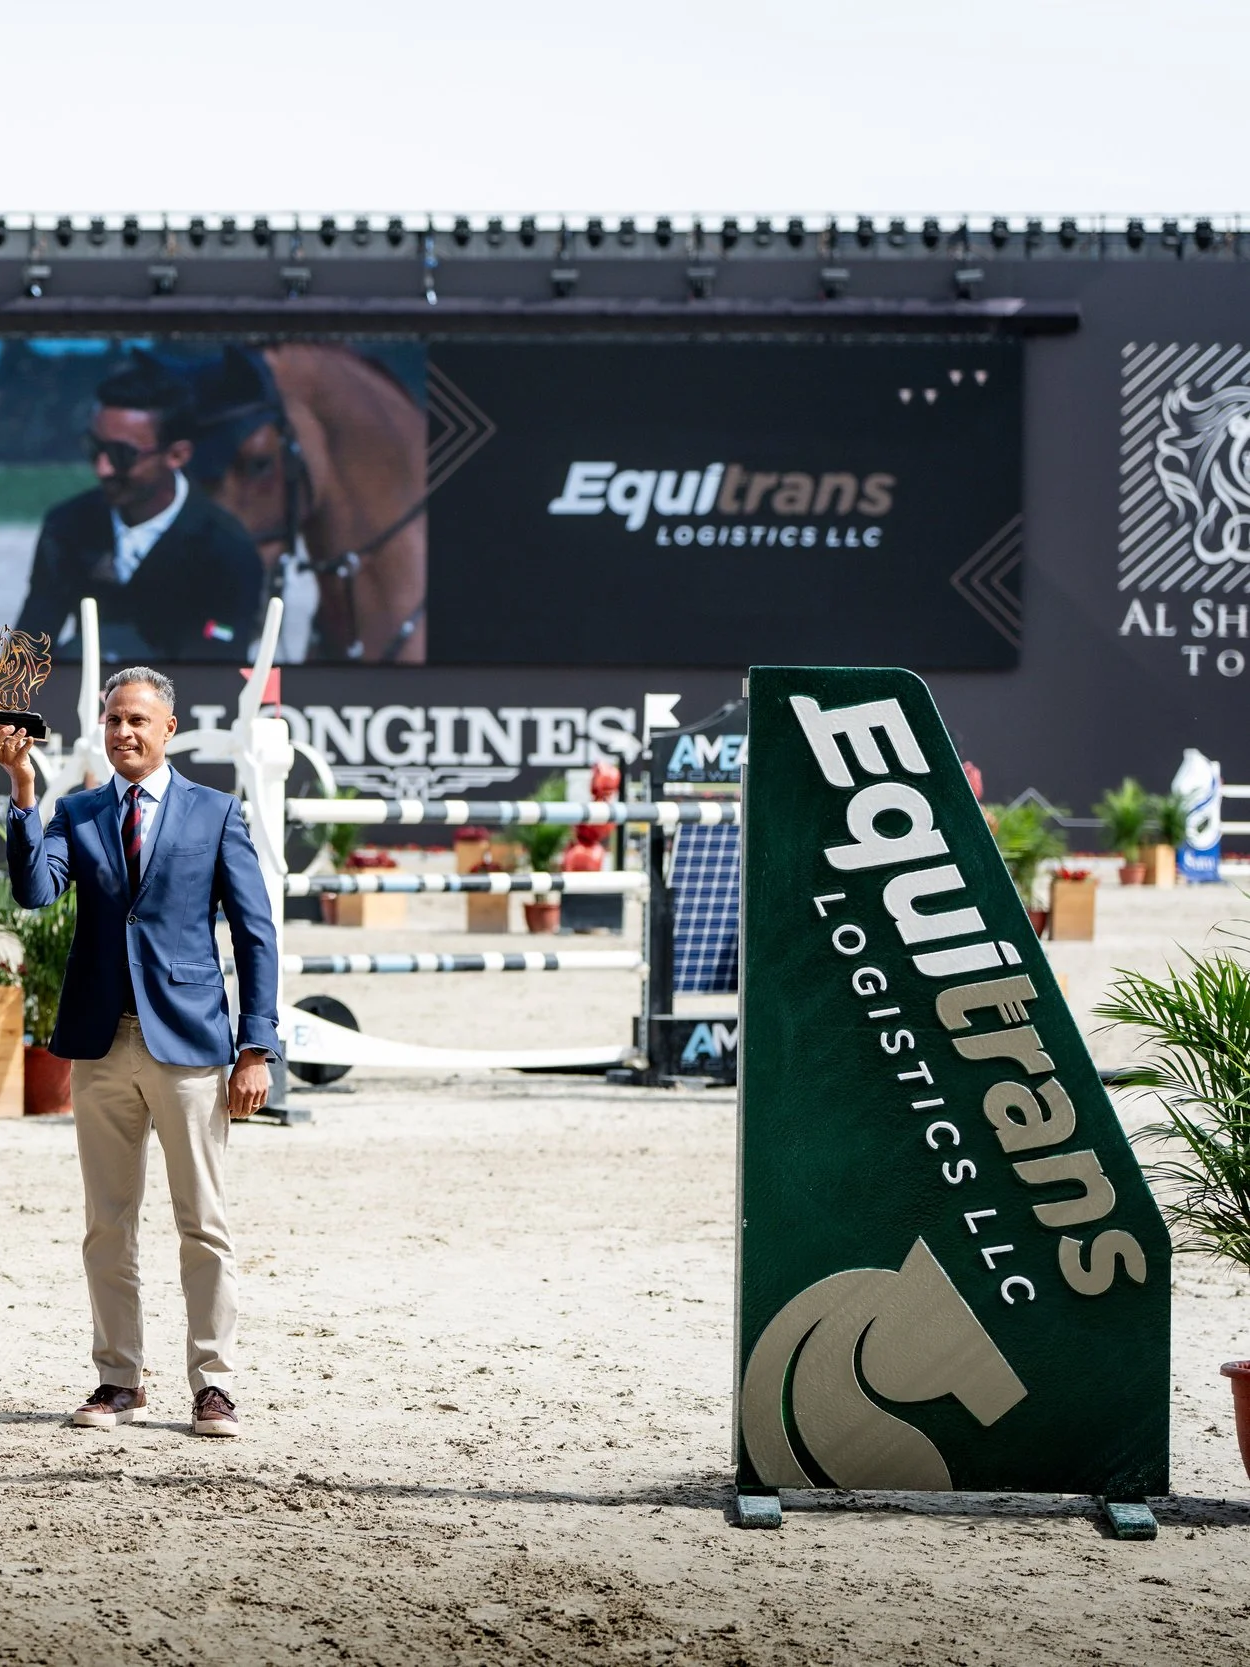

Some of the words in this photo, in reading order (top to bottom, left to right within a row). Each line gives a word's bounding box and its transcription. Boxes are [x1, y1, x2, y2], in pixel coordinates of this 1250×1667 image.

[547, 461, 896, 531] Equitrans
[656, 525, 818, 547] LOGISTICS
[826, 526, 883, 548] LLC
[1118, 598, 1177, 637] AL
[788, 695, 1147, 1296] Equitrans
[813, 891, 977, 1186] LOGISTICS
[963, 1208, 1035, 1306] LLC
